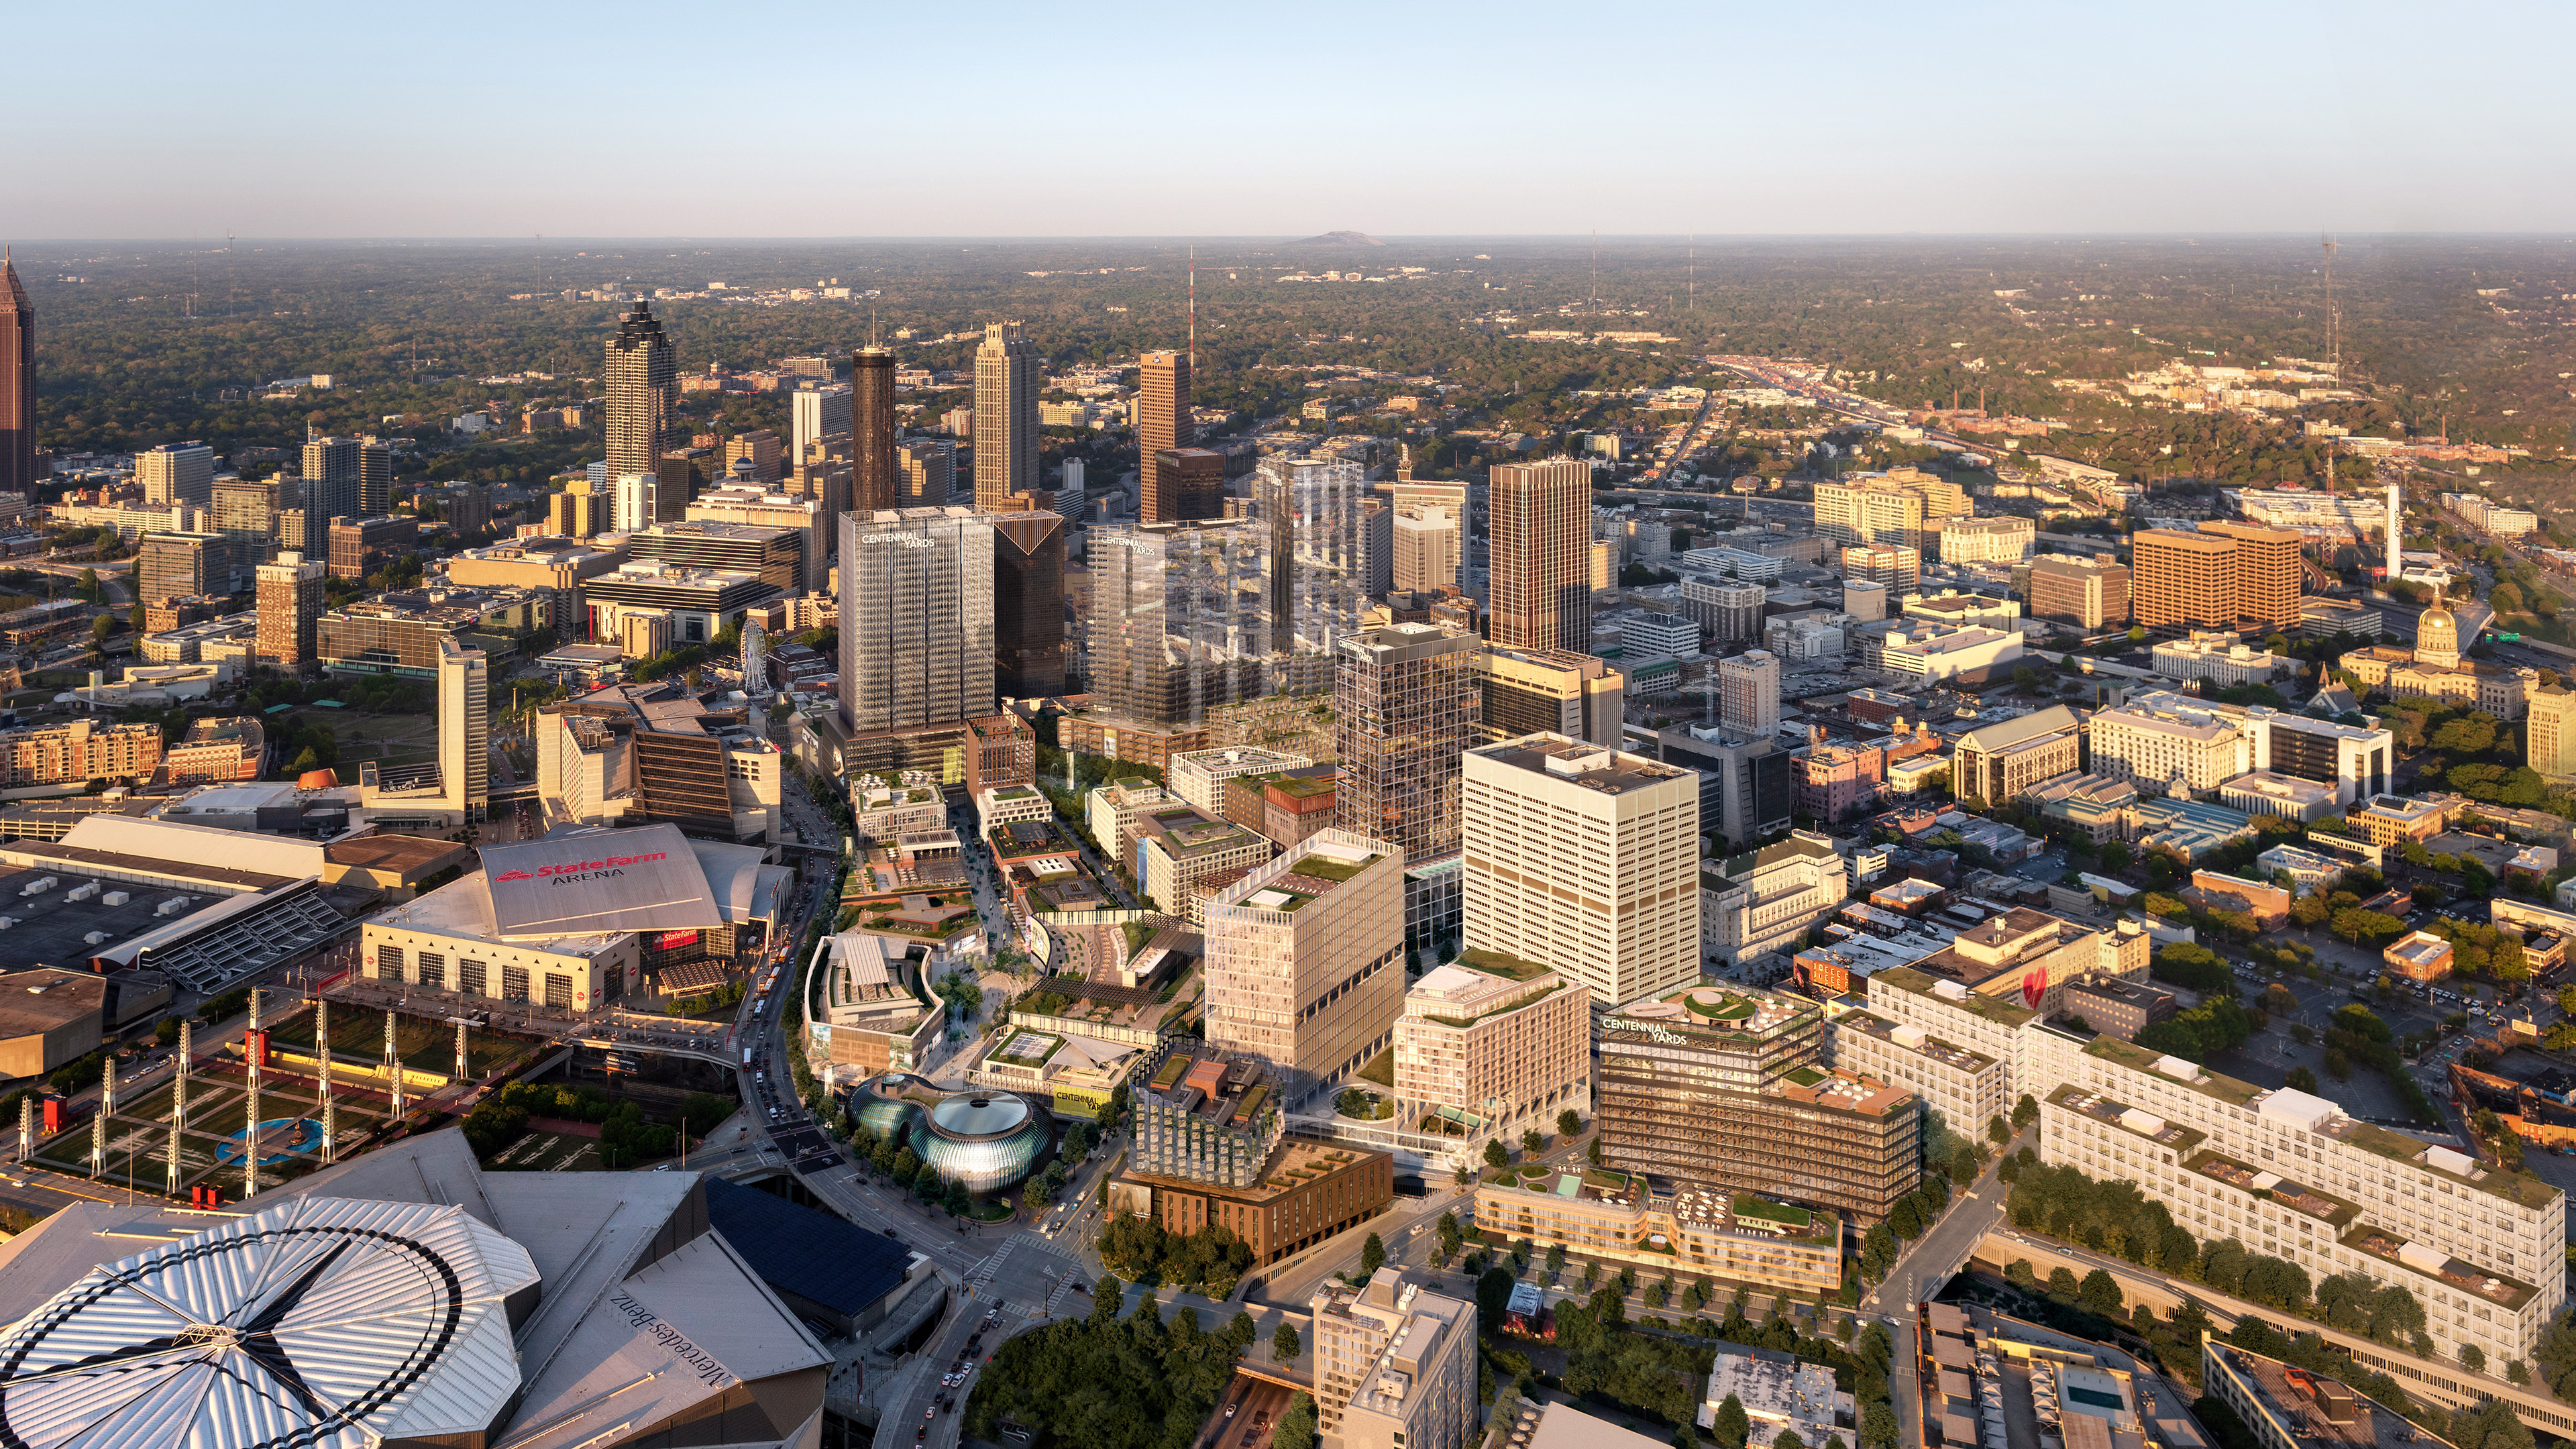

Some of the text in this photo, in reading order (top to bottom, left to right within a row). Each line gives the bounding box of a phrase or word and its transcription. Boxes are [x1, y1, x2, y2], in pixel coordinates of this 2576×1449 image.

[862, 532, 919, 543] CENTENNIAL
[1102, 537, 1143, 547] CENTENNIAL
[904, 539, 934, 549] YARDS
[1132, 546, 1155, 555] YARDS
[1338, 640, 1364, 653] CENTENNIAL
[1358, 652, 1373, 663] YARDS
[552, 868, 625, 885] ARENA
[1603, 1019, 1668, 1034] CENTENNIAL
[1652, 1032, 1687, 1046] YARDS
[1057, 1091, 1098, 1104] CENTENNIAL
[1087, 1103, 1101, 1111] YAR
[610, 1294, 733, 1387] Mercedes-Benz
